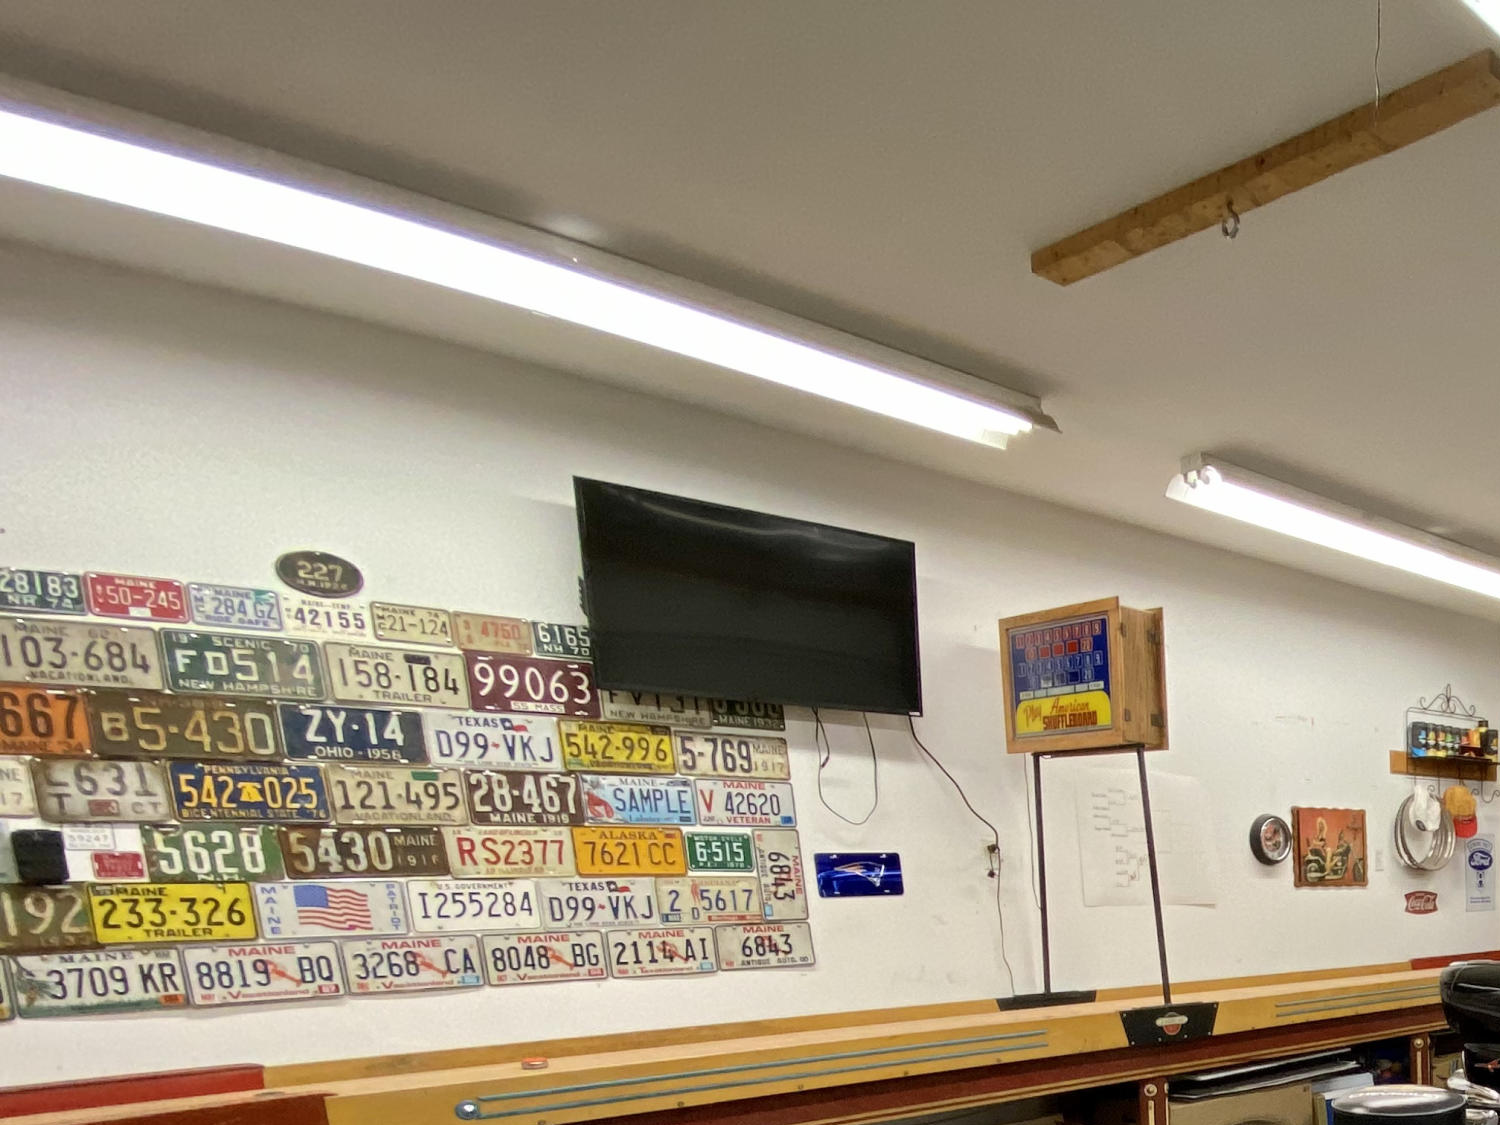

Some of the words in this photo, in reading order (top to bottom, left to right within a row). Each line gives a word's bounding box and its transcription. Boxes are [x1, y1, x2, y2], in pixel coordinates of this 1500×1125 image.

[298, 561, 343, 583] 227
[106, 585, 181, 610] 50-245
[294, 607, 366, 630] 42155
[211, 636, 271, 651] SCENIC
[537, 622, 591, 648] 6165
[1, 633, 150, 675] 103-684
[178, 679, 215, 691] NEW
[473, 661, 592, 705] 99063
[372, 689, 432, 704] TRAILER
[534, 703, 565, 713] MASS
[457, 715, 500, 730] TEXAS
[610, 709, 635, 719] NEW
[315, 745, 354, 759] OHIO
[565, 732, 668, 763] 542-996
[679, 735, 753, 774] 5-769
[336, 779, 461, 811] 121-495
[469, 772, 578, 815] 28-467
[722, 781, 766, 790] MAINE
[613, 788, 692, 816] SAMPLE
[699, 789, 715, 814] V
[724, 791, 782, 817] 42620
[489, 812, 537, 824] MAINE
[725, 816, 772, 825] VETERAN
[393, 834, 438, 847] MAINE
[598, 830, 659, 842] ALASKA
[154, 829, 266, 876] 5628
[288, 829, 394, 874] 5430
[583, 841, 642, 868] 7621
[648, 842, 677, 867] CC
[567, 881, 605, 892] TEXAS
[768, 851, 796, 901] 6843
[115, 886, 169, 897] MAINE
[699, 888, 753, 912] 5617
[98, 897, 246, 929] 233-326
[143, 927, 213, 938] TRAILER
[517, 933, 571, 944] MAINE
[638, 929, 686, 939] MAINE
[742, 925, 785, 934] MAINE
[228, 945, 297, 957] MAINE
[381, 938, 442, 950] MAINE
[613, 939, 675, 966] 2114
[684, 937, 710, 961] AI
[741, 933, 793, 958] 6843
[57, 950, 135, 964] MAINE
[352, 950, 420, 980] 3268
[444, 948, 476, 975] CA
[491, 945, 551, 972] 8048
[571, 943, 600, 968] BG
[46, 965, 130, 1000] 3709
[138, 962, 180, 994] KR
[195, 958, 272, 990] 8819
